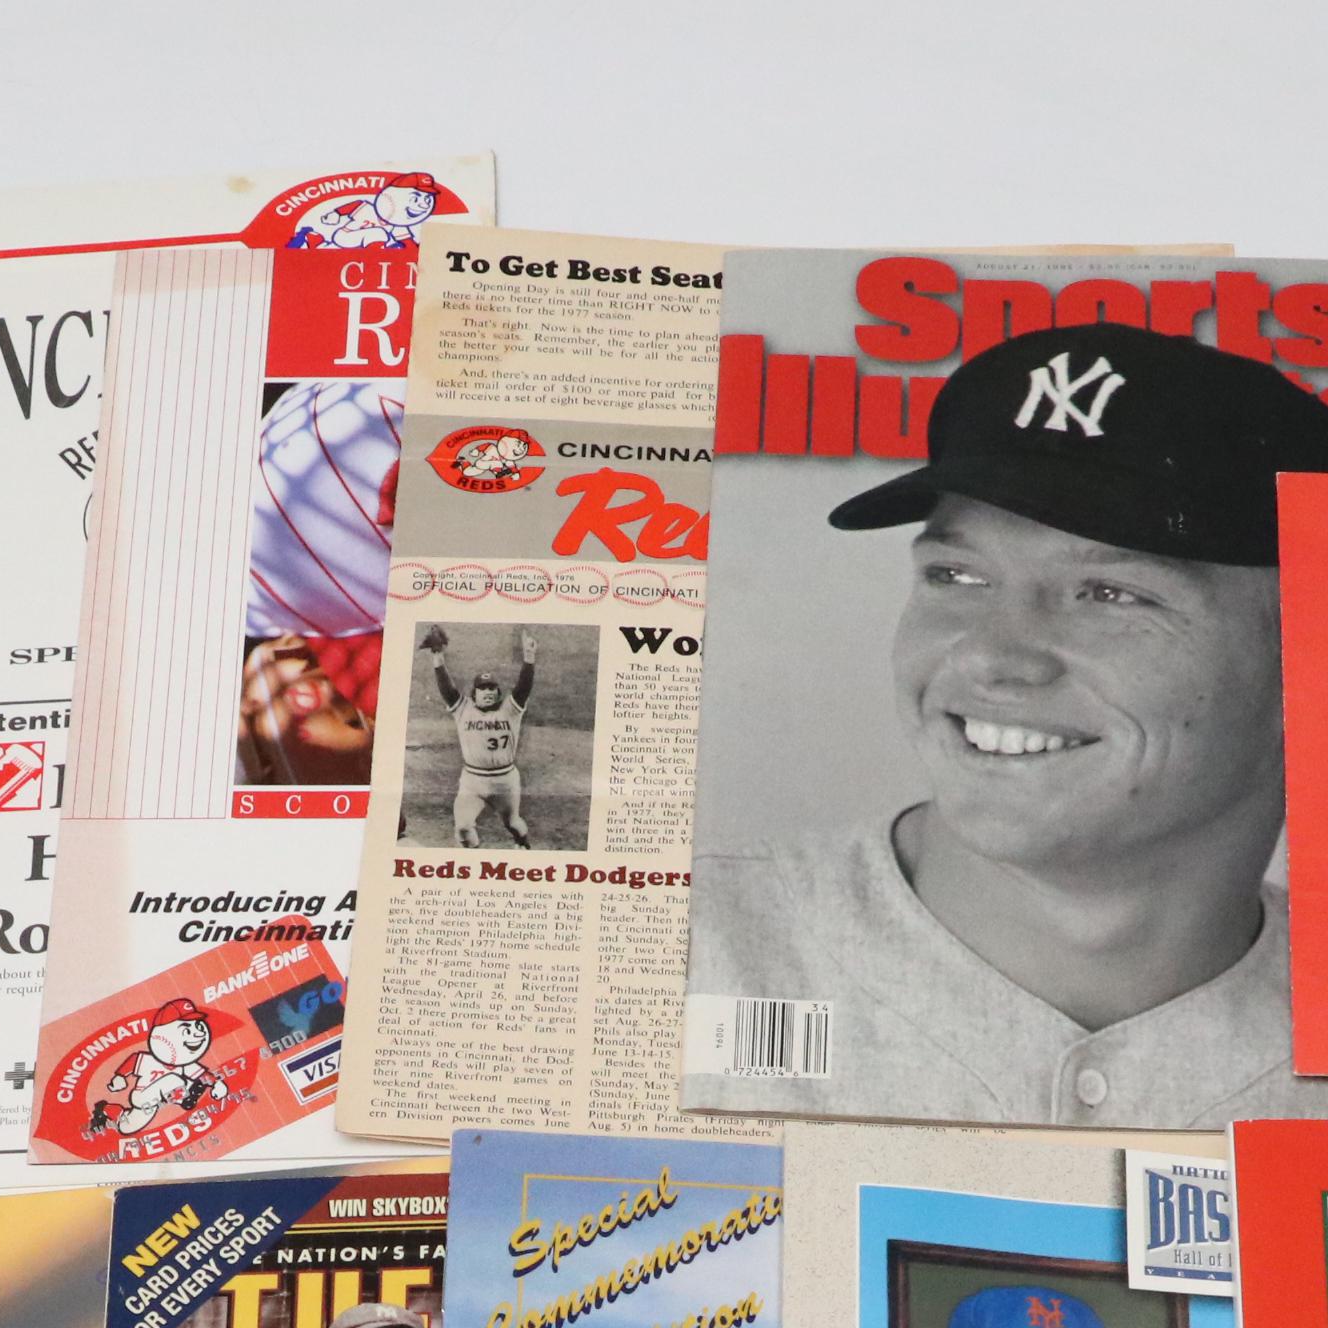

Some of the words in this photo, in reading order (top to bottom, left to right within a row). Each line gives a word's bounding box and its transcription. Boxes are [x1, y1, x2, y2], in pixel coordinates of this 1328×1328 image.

[275, 176, 386, 216] CINCINNATI
[446, 251, 490, 273] To
[499, 256, 558, 278] Get
[567, 260, 641, 284] Best
[456, 476, 506, 491] REDS
[412, 579, 476, 591] OFFICIAL
[484, 581, 580, 594] PUBLICATION
[589, 585, 608, 594] OF
[615, 586, 698, 598] CINCINNATI
[486, 735, 510, 752] 37
[393, 859, 471, 879] Reds
[479, 862, 556, 882] Meet
[565, 864, 691, 889] Dodgers
[129, 890, 326, 917] Introducing
[335, 890, 357, 911] A
[422, 888, 441, 898] pair
[450, 888, 461, 896] of
[470, 889, 515, 897] weekend
[524, 891, 553, 900] series
[561, 892, 583, 900] with
[178, 920, 351, 944] Cincinnati
[203, 968, 257, 1004] BANK
[269, 944, 310, 971] ONE
[812, 1003, 829, 1013] 34
[56, 1018, 149, 1104] CINCINNATI
[118, 1115, 213, 1160] REDS
[328, 1199, 366, 1217] WIN
[372, 1197, 446, 1217] SKYBOX
[508, 1167, 678, 1278] Special
[122, 1204, 202, 1278] NEW
[278, 1246, 404, 1263] NATION'S
[124, 1265, 179, 1316] CARD
[175, 1208, 244, 1271] PRICES
[161, 1260, 222, 1316] EVERY
[219, 1206, 282, 1265] SPORT
[1174, 1250, 1202, 1266] Hall
[1208, 1252, 1222, 1268] of
